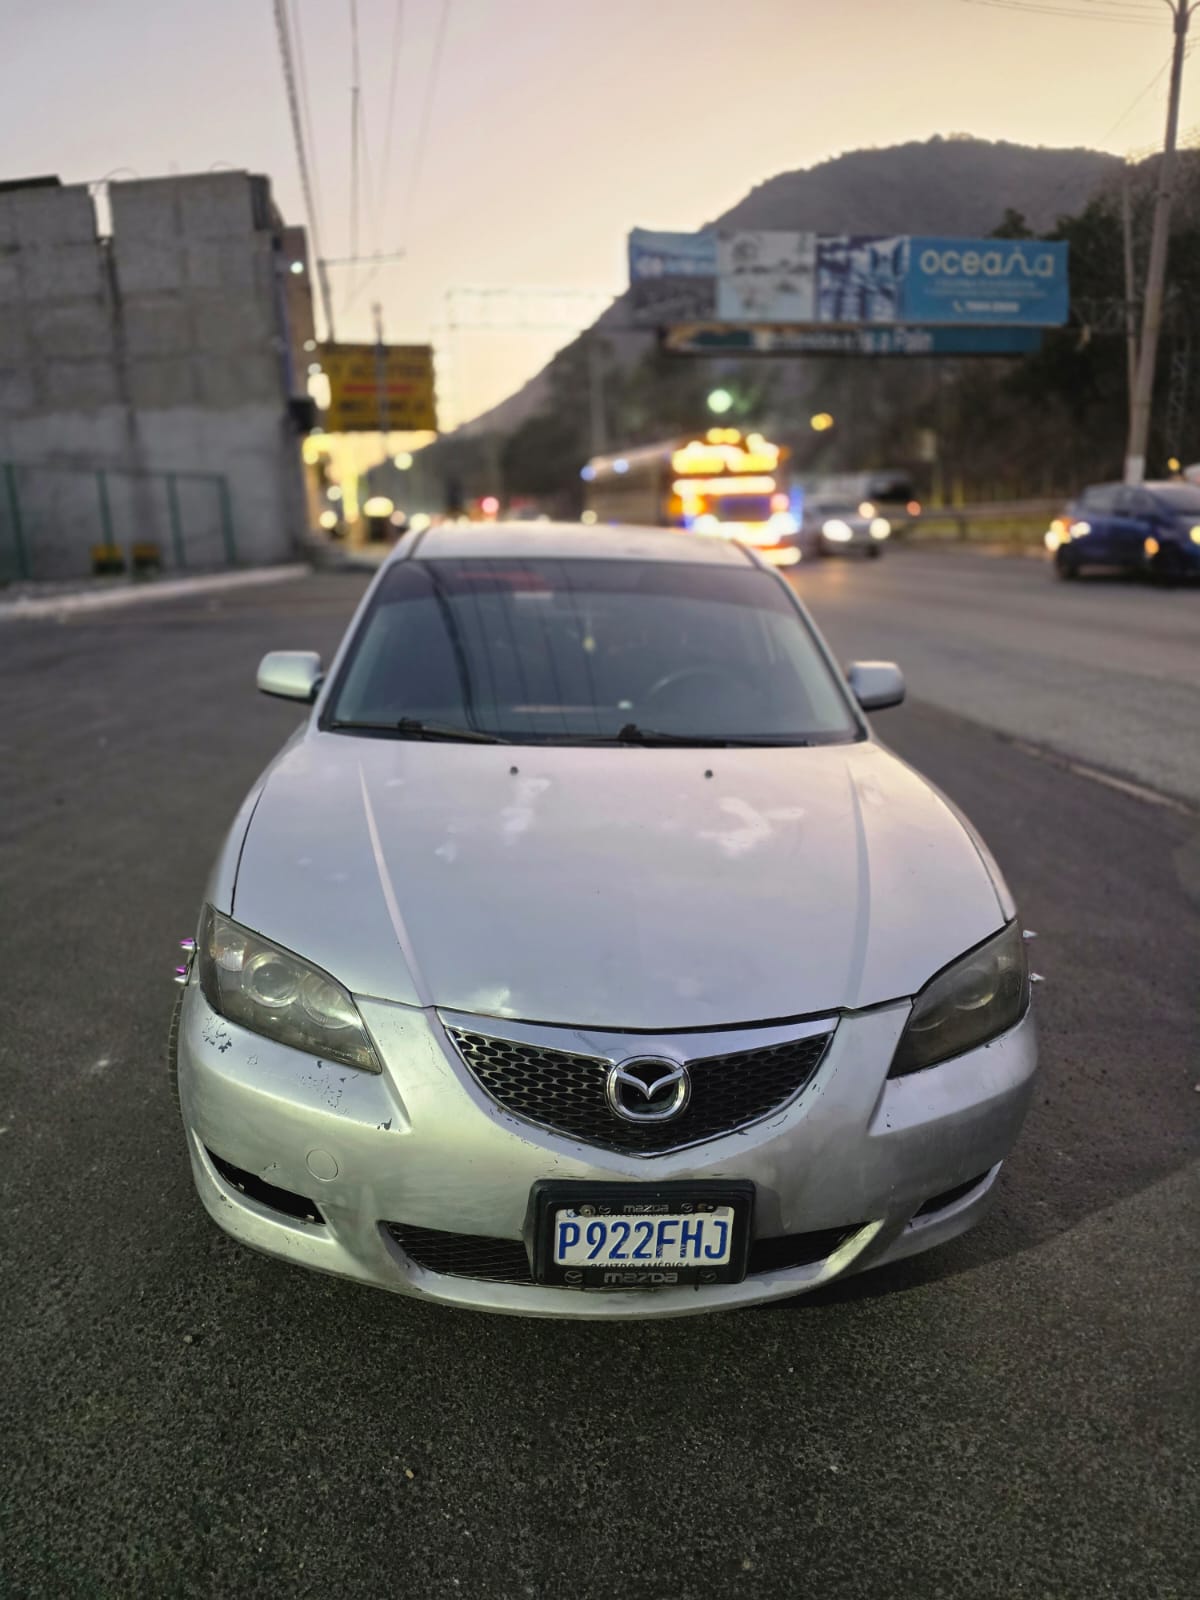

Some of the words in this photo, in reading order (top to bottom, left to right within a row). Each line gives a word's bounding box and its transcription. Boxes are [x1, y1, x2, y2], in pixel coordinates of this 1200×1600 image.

[624, 1204, 669, 1213] mazda
[558, 1219, 728, 1260] P922FHJ
[604, 1272, 678, 1283] mazda
